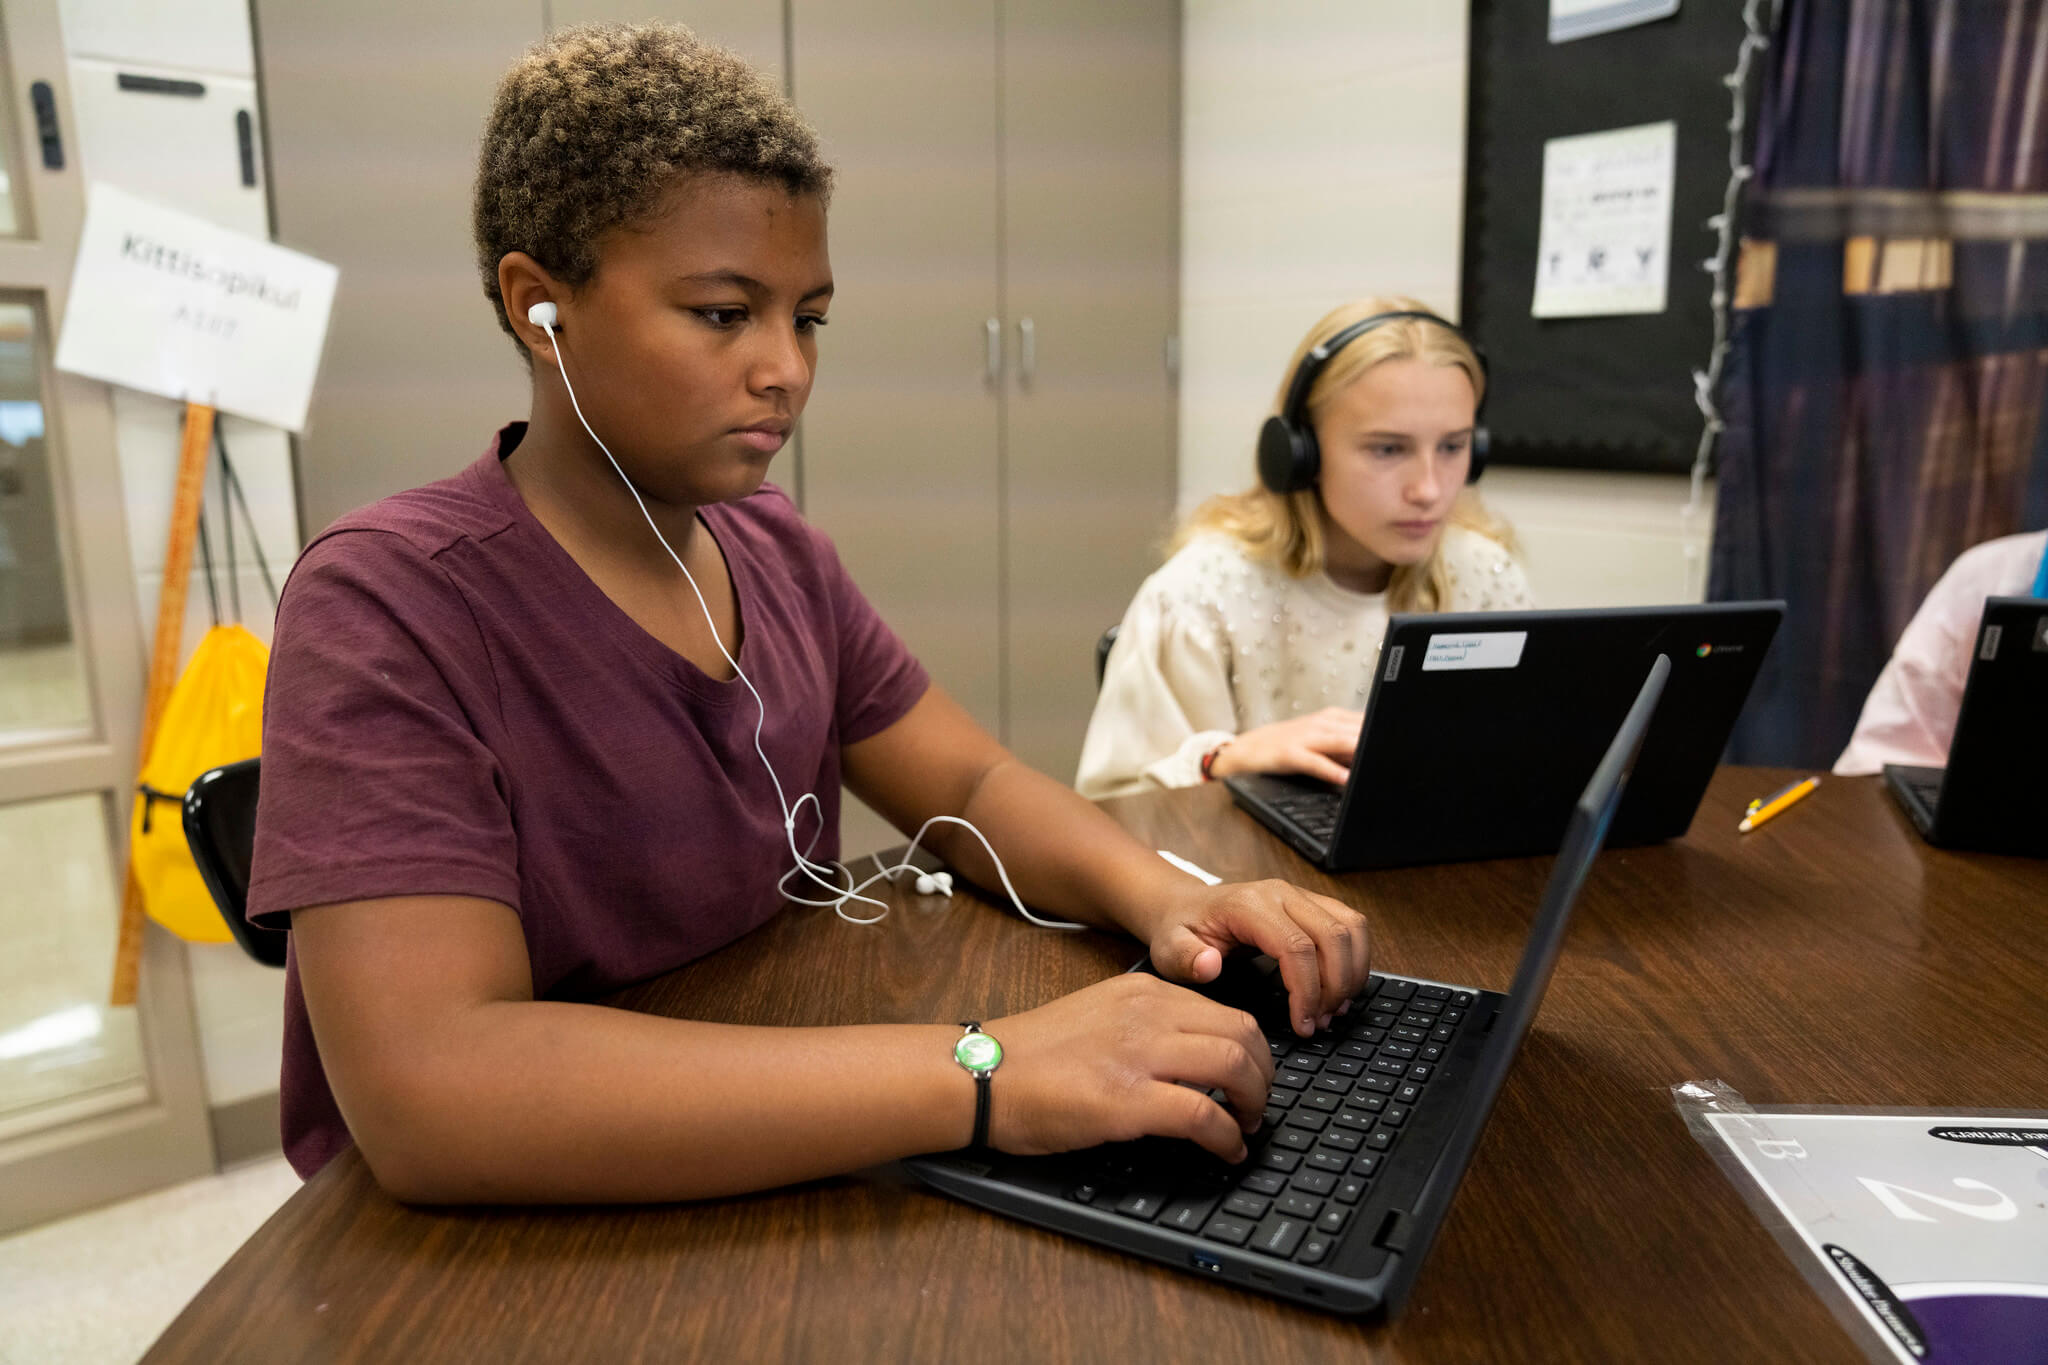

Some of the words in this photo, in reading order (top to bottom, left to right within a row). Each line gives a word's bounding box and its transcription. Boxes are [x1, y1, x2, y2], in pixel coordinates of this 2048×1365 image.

[121, 232, 300, 309] Kittisopikul
[1948, 1131, 2023, 1141] Partners
[2022, 1132, 2048, 1141] ace
[1752, 1137, 1808, 1160] B
[1856, 1176, 2018, 1222] 2
